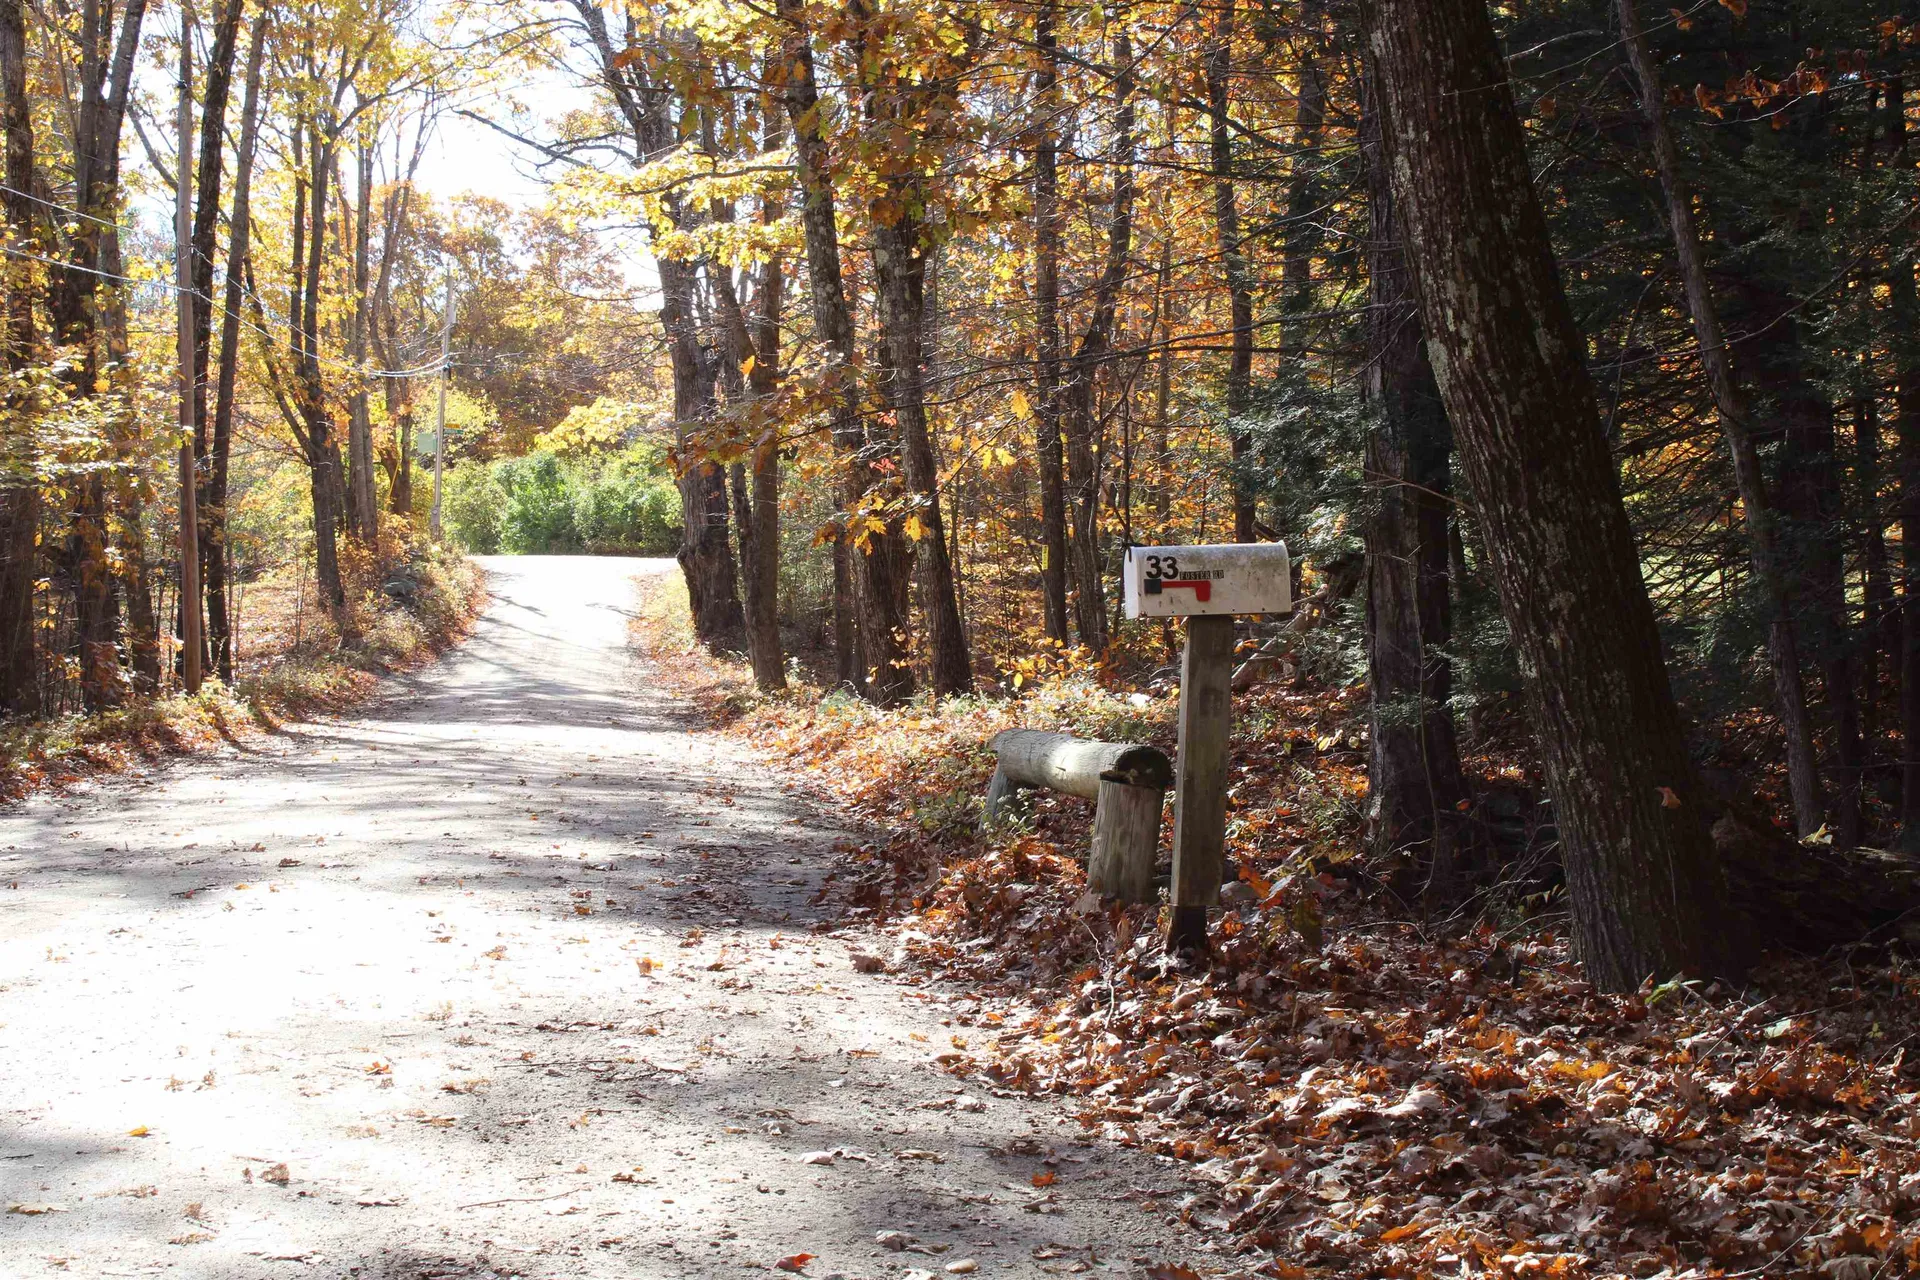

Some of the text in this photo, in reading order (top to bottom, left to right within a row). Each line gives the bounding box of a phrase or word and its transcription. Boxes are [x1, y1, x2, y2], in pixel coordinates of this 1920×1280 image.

[1145, 555, 1224, 580] 33 FOSTER RD
